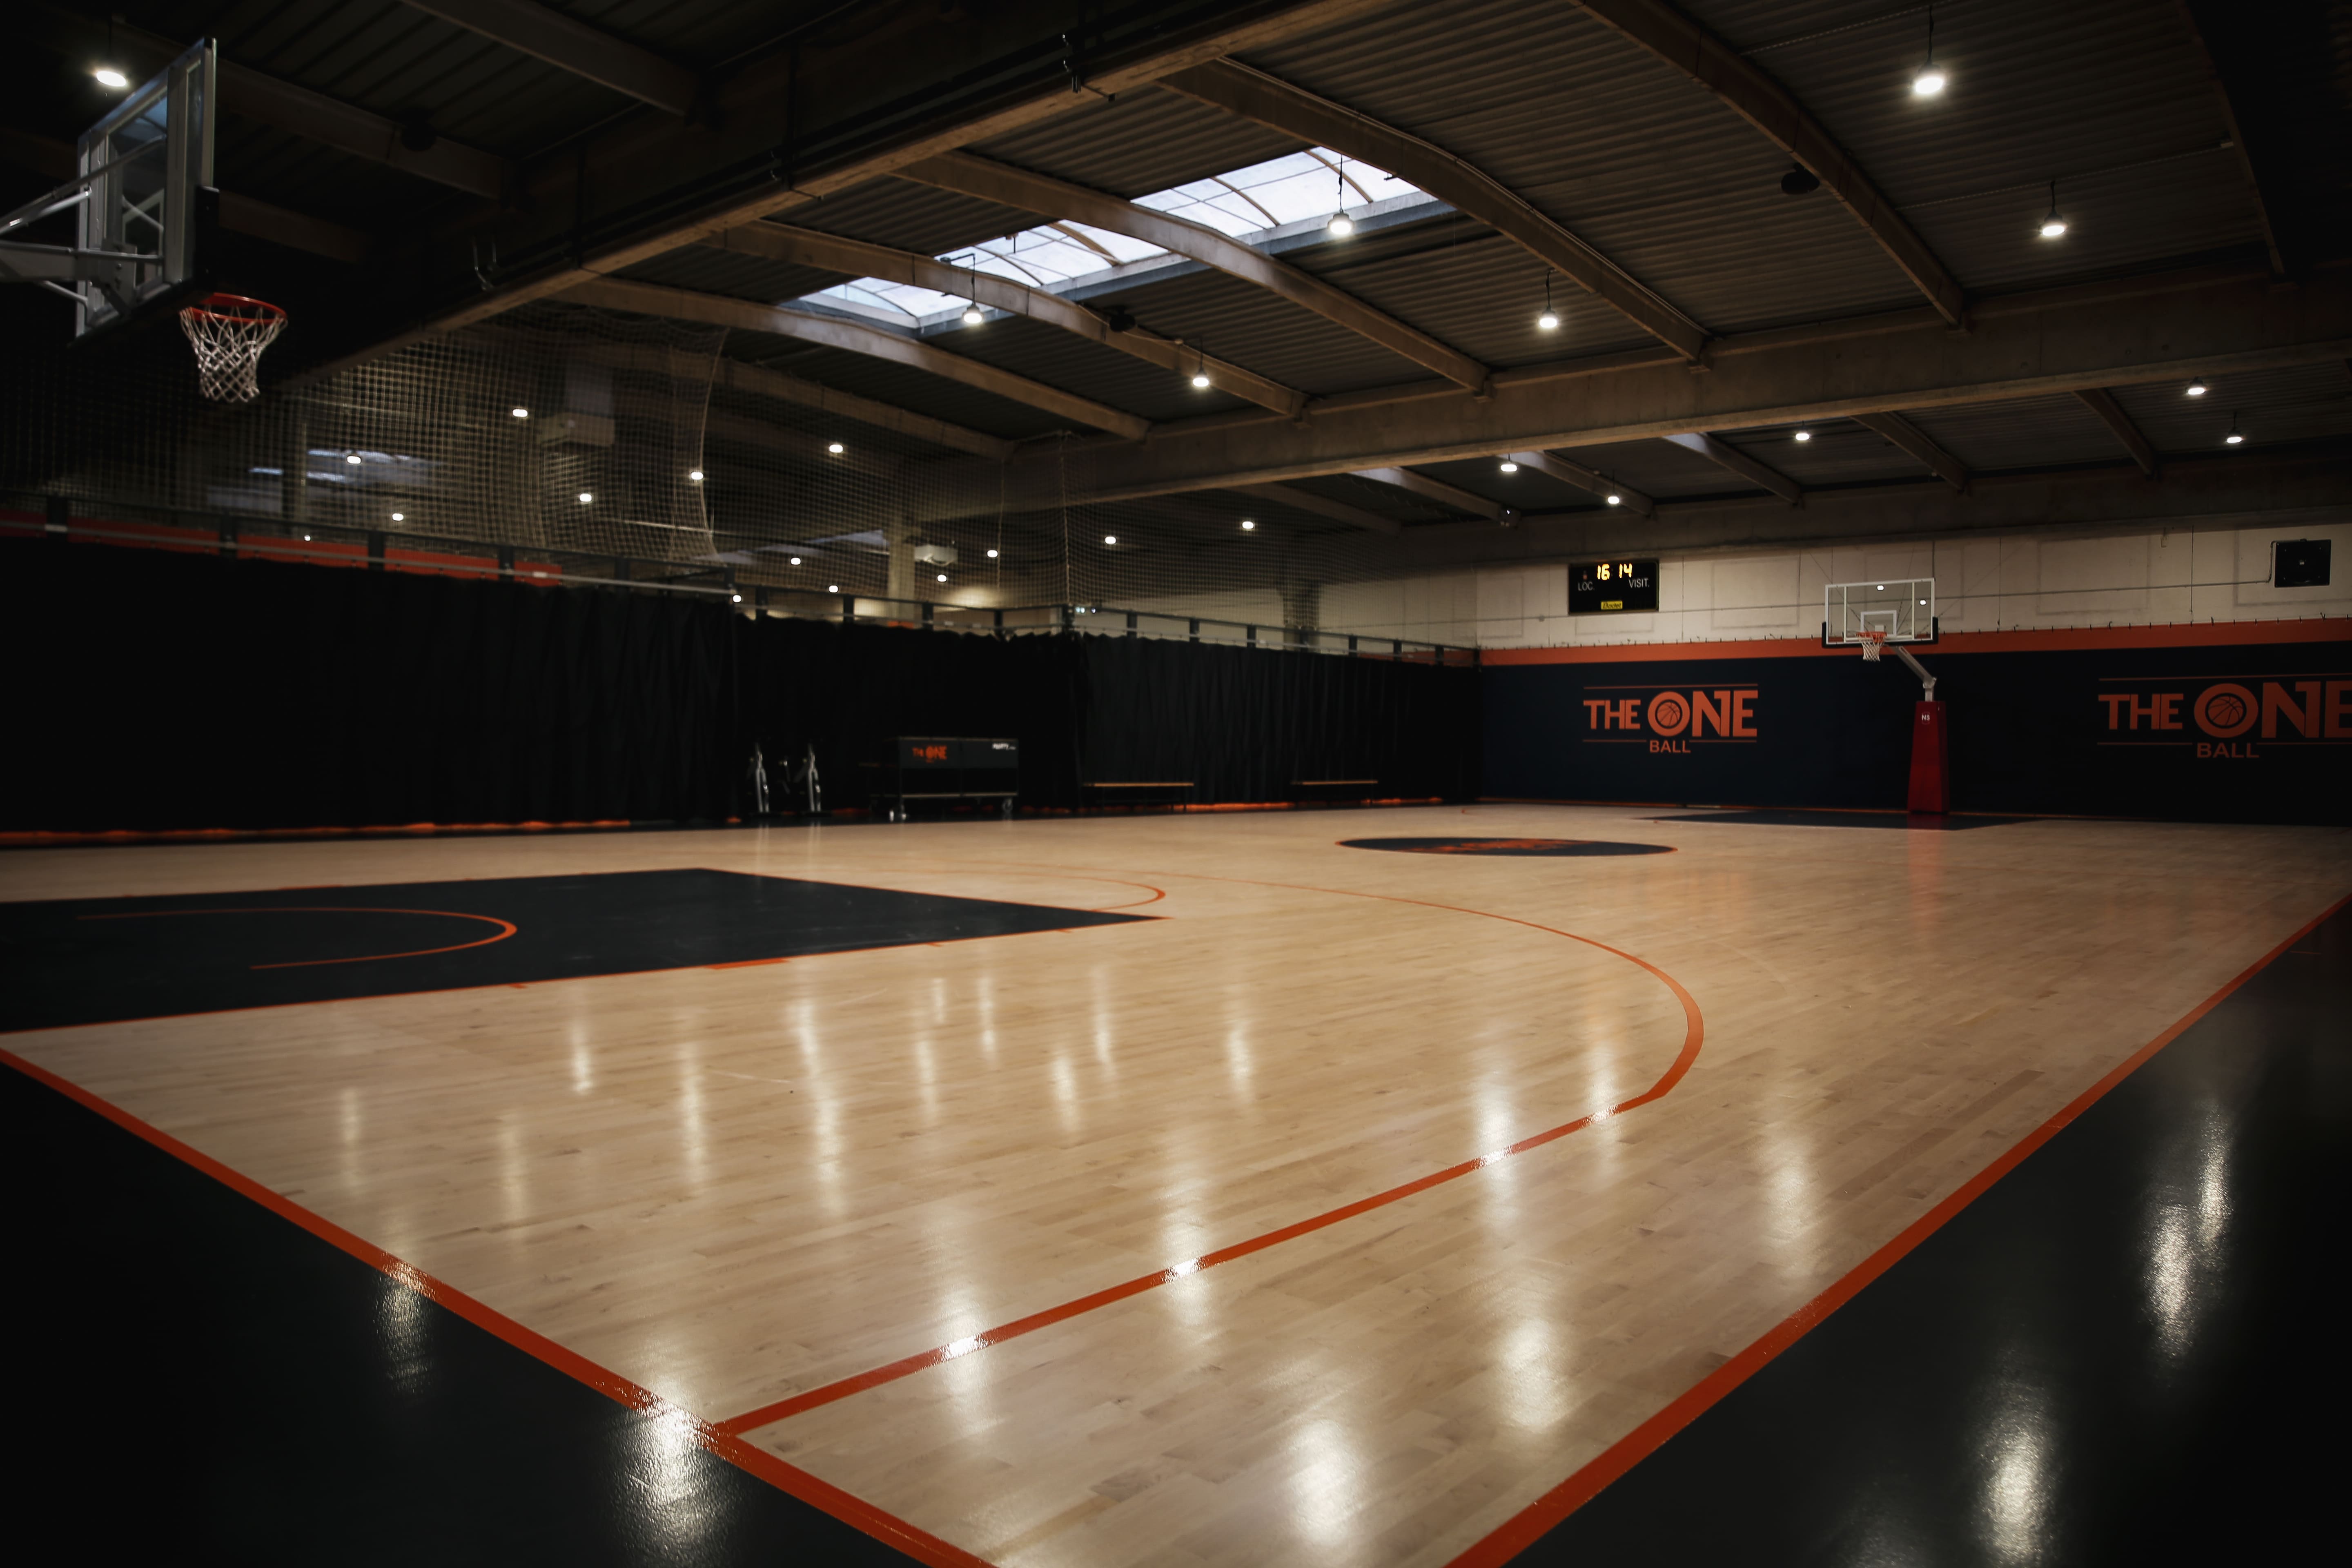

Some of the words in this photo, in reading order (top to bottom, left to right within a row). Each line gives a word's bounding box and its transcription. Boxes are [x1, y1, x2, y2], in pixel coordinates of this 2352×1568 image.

[1583, 699, 1641, 729] THE
[1648, 690, 1758, 737] ONE
[2098, 693, 2183, 729] THE
[2194, 681, 2352, 738] ONE
[1650, 740, 1691, 753] BALL
[2196, 743, 2259, 758] BALL
